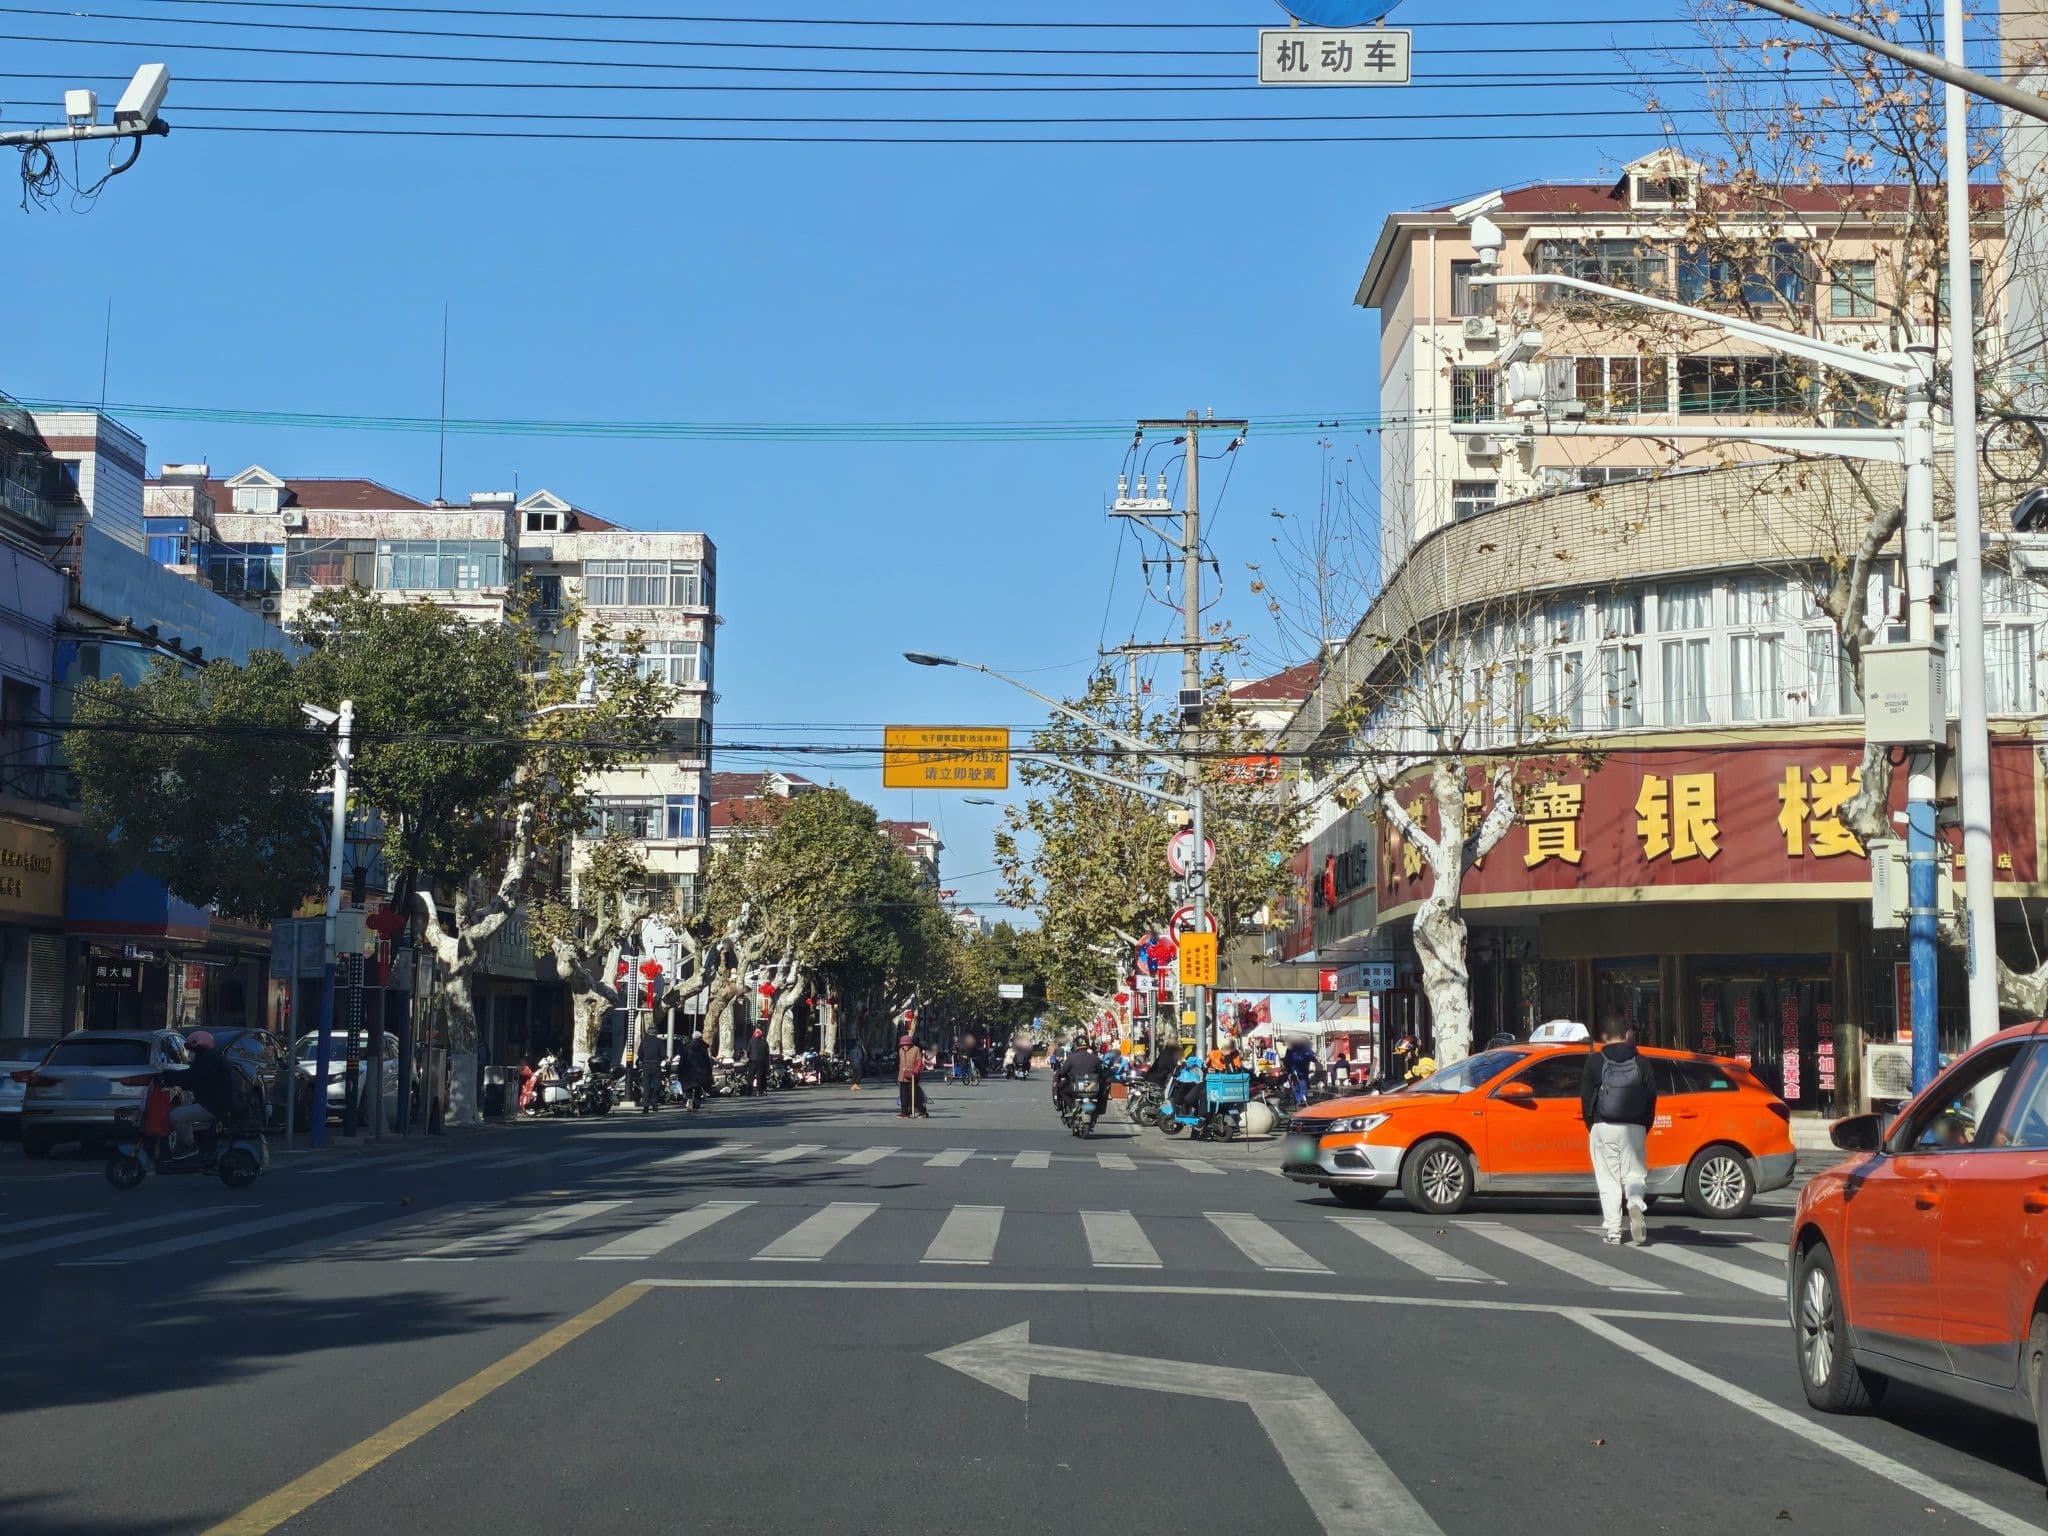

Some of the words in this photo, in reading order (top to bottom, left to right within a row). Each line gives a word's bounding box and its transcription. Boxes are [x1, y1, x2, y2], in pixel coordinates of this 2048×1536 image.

[1276, 39, 1396, 73] 机动车
[925, 767, 997, 781] 请立即驶离
